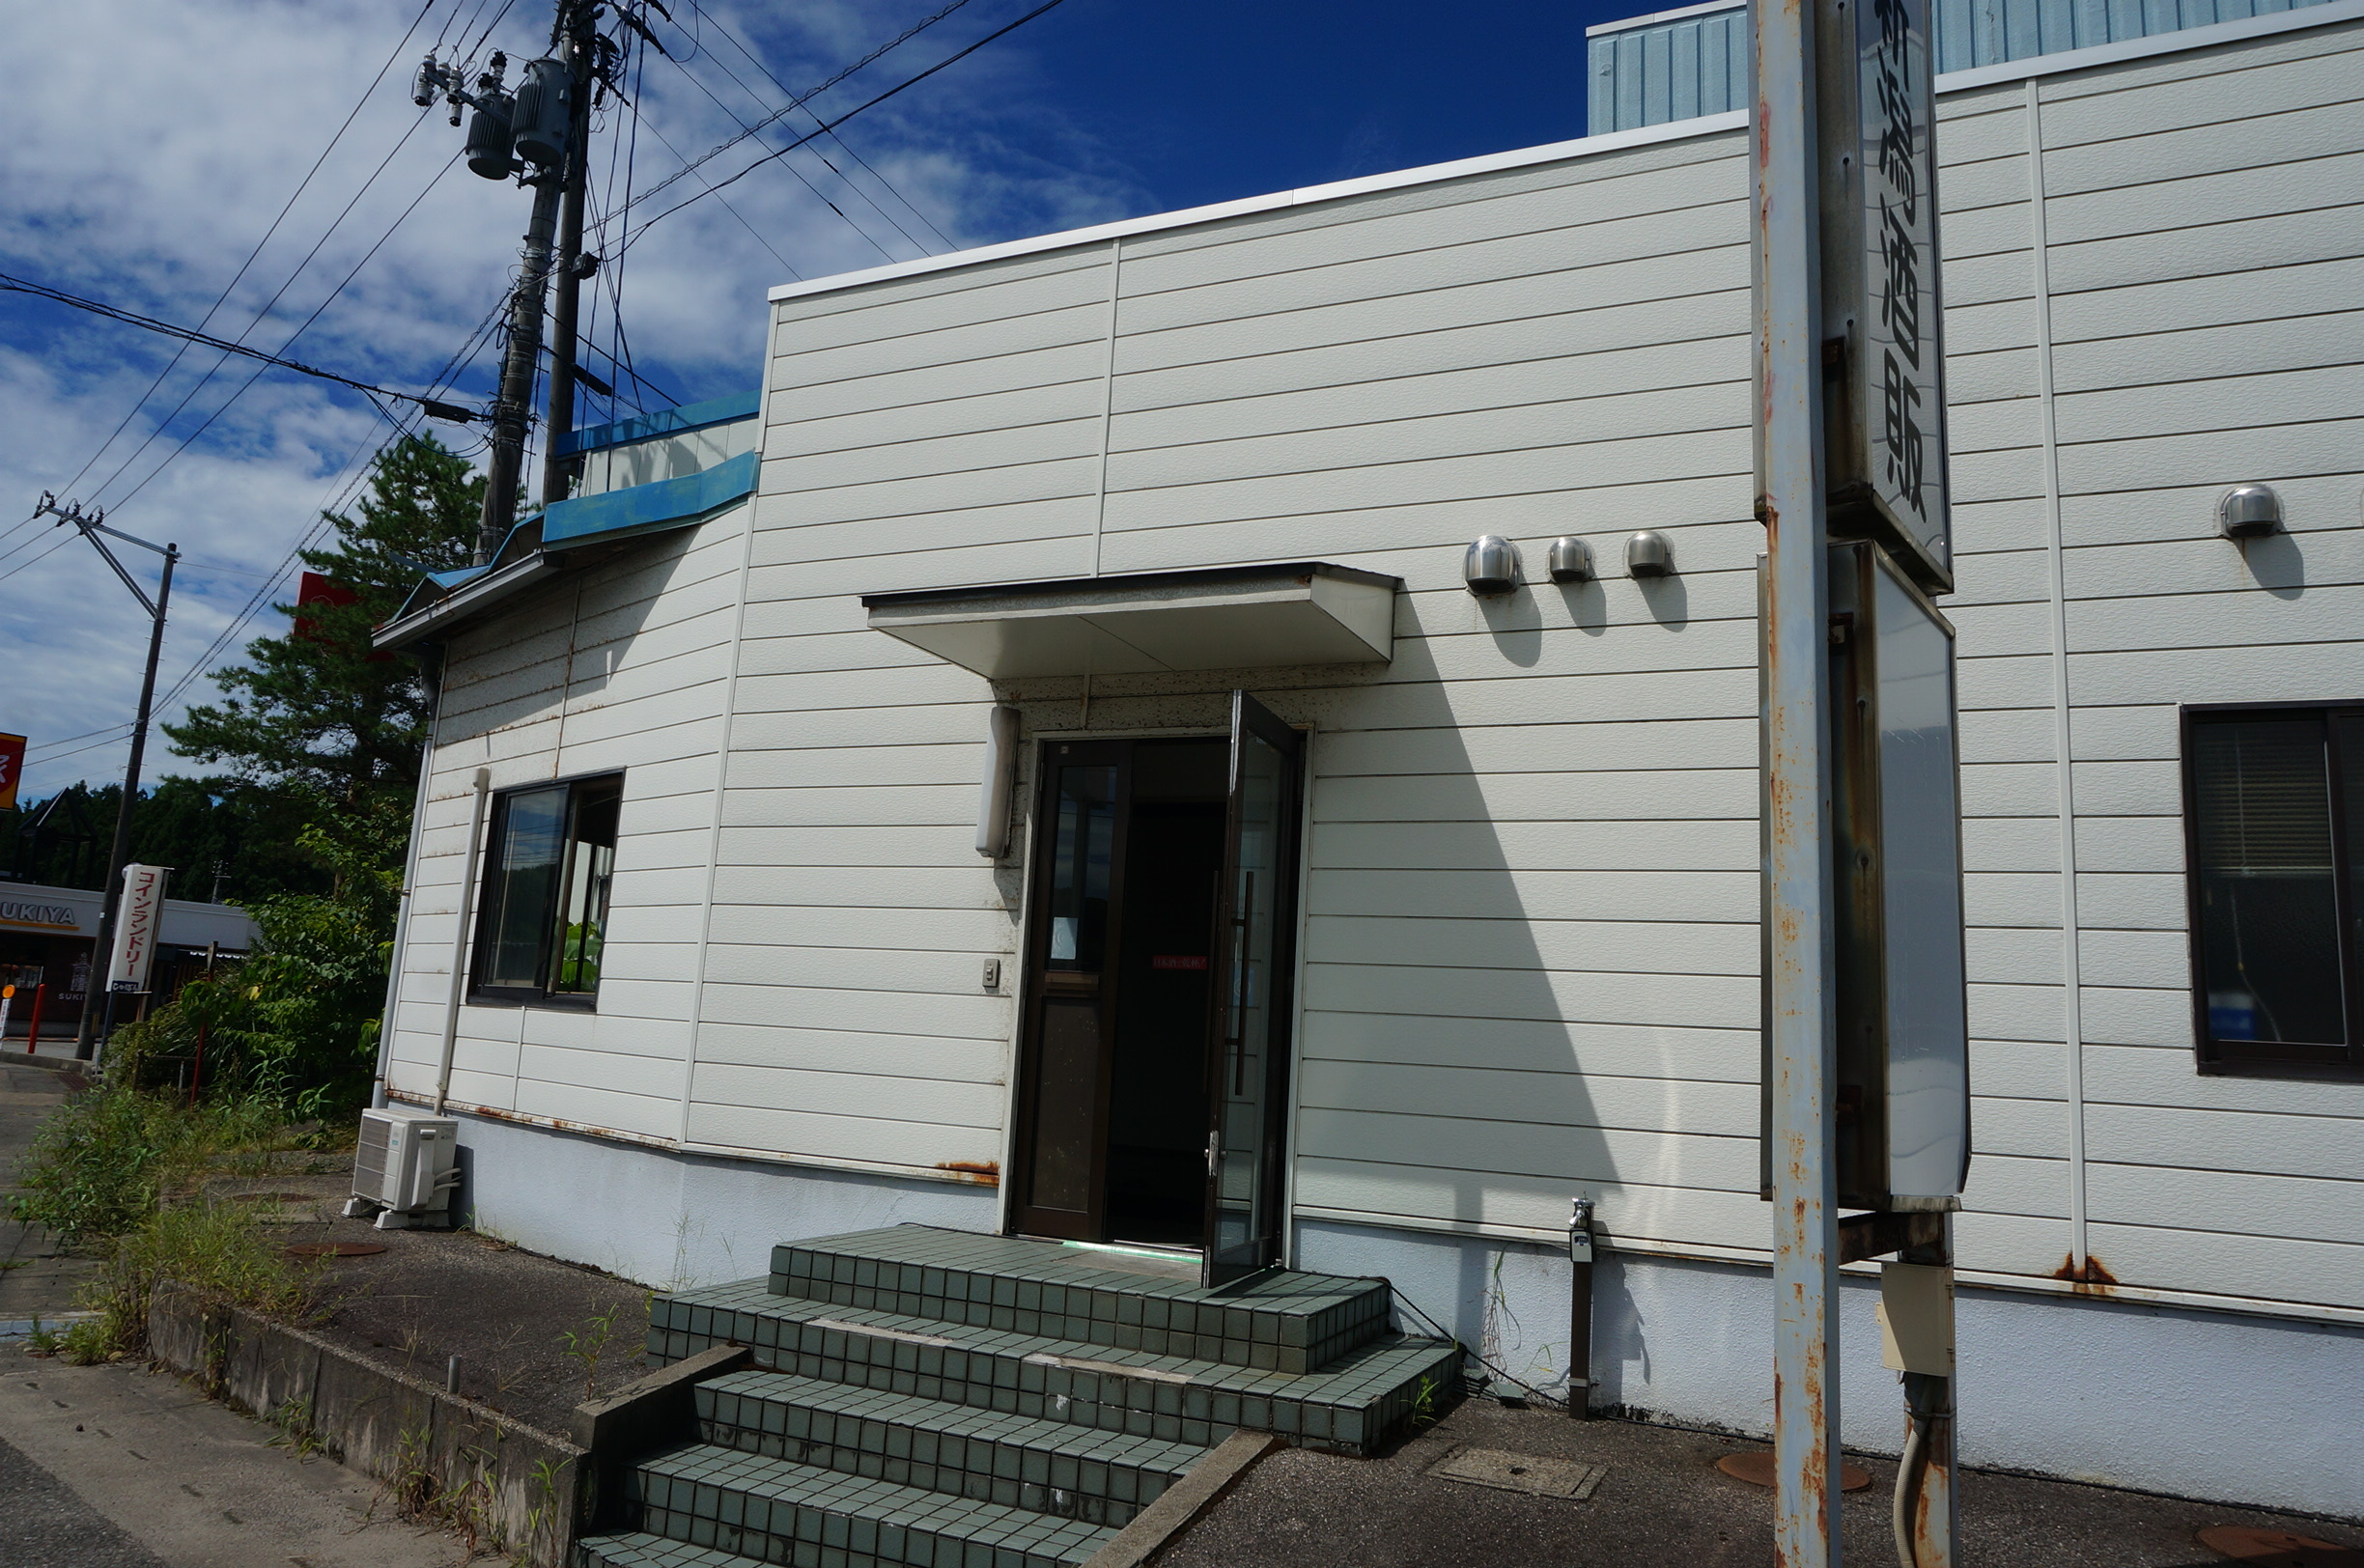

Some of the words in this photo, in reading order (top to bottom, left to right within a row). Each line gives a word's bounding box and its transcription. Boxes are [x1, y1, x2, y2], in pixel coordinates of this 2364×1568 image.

[0, 901, 75, 924] UKIYA
[126, 872, 155, 976] コインランドリー
